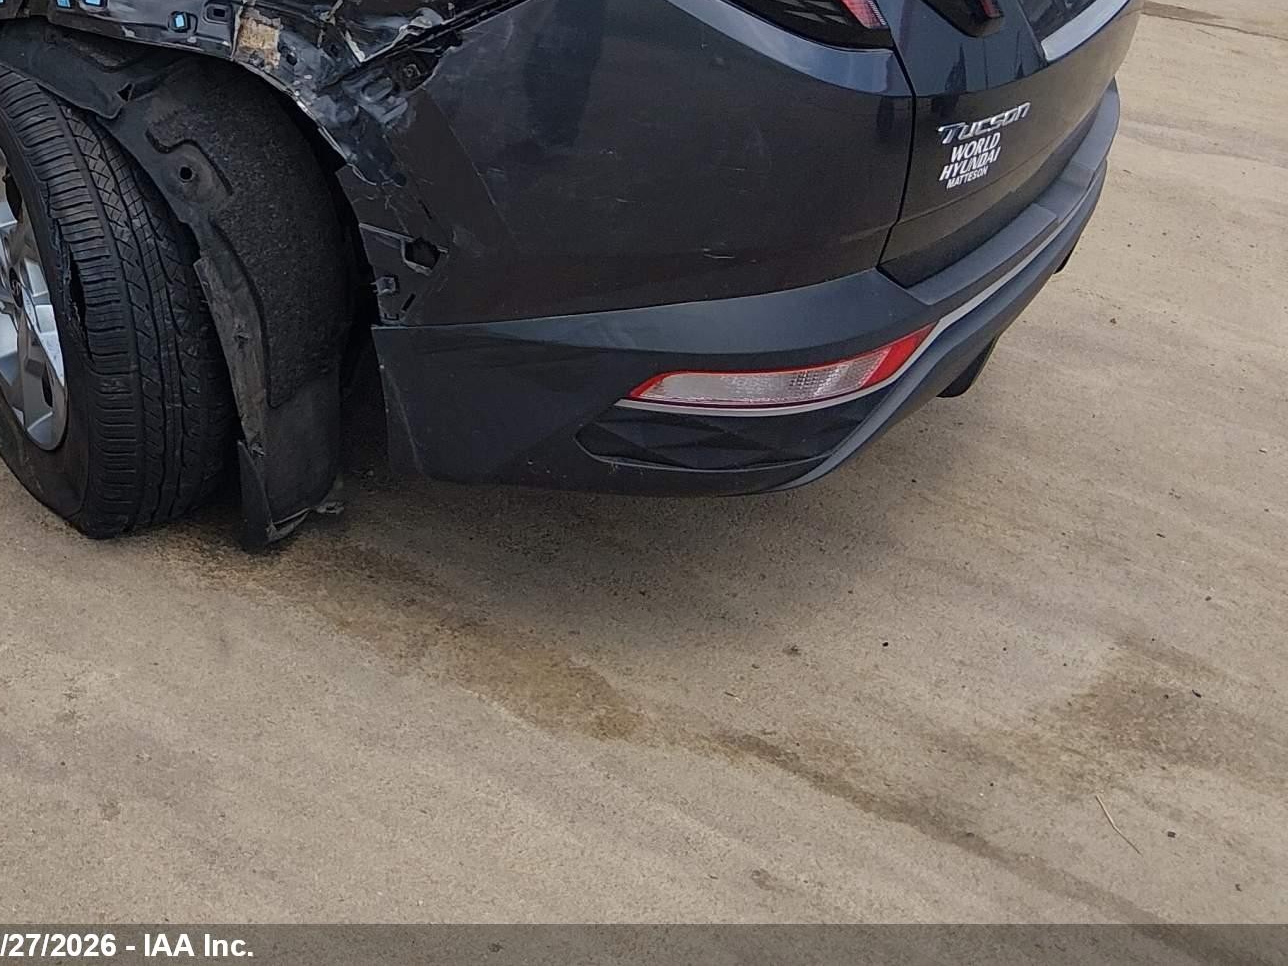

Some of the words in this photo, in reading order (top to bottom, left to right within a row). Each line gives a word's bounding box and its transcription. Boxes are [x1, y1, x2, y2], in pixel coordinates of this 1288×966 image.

[951, 132, 1001, 163] WORLD
[939, 146, 1002, 182] HYUNDAI
[946, 166, 989, 189] MATTESON
